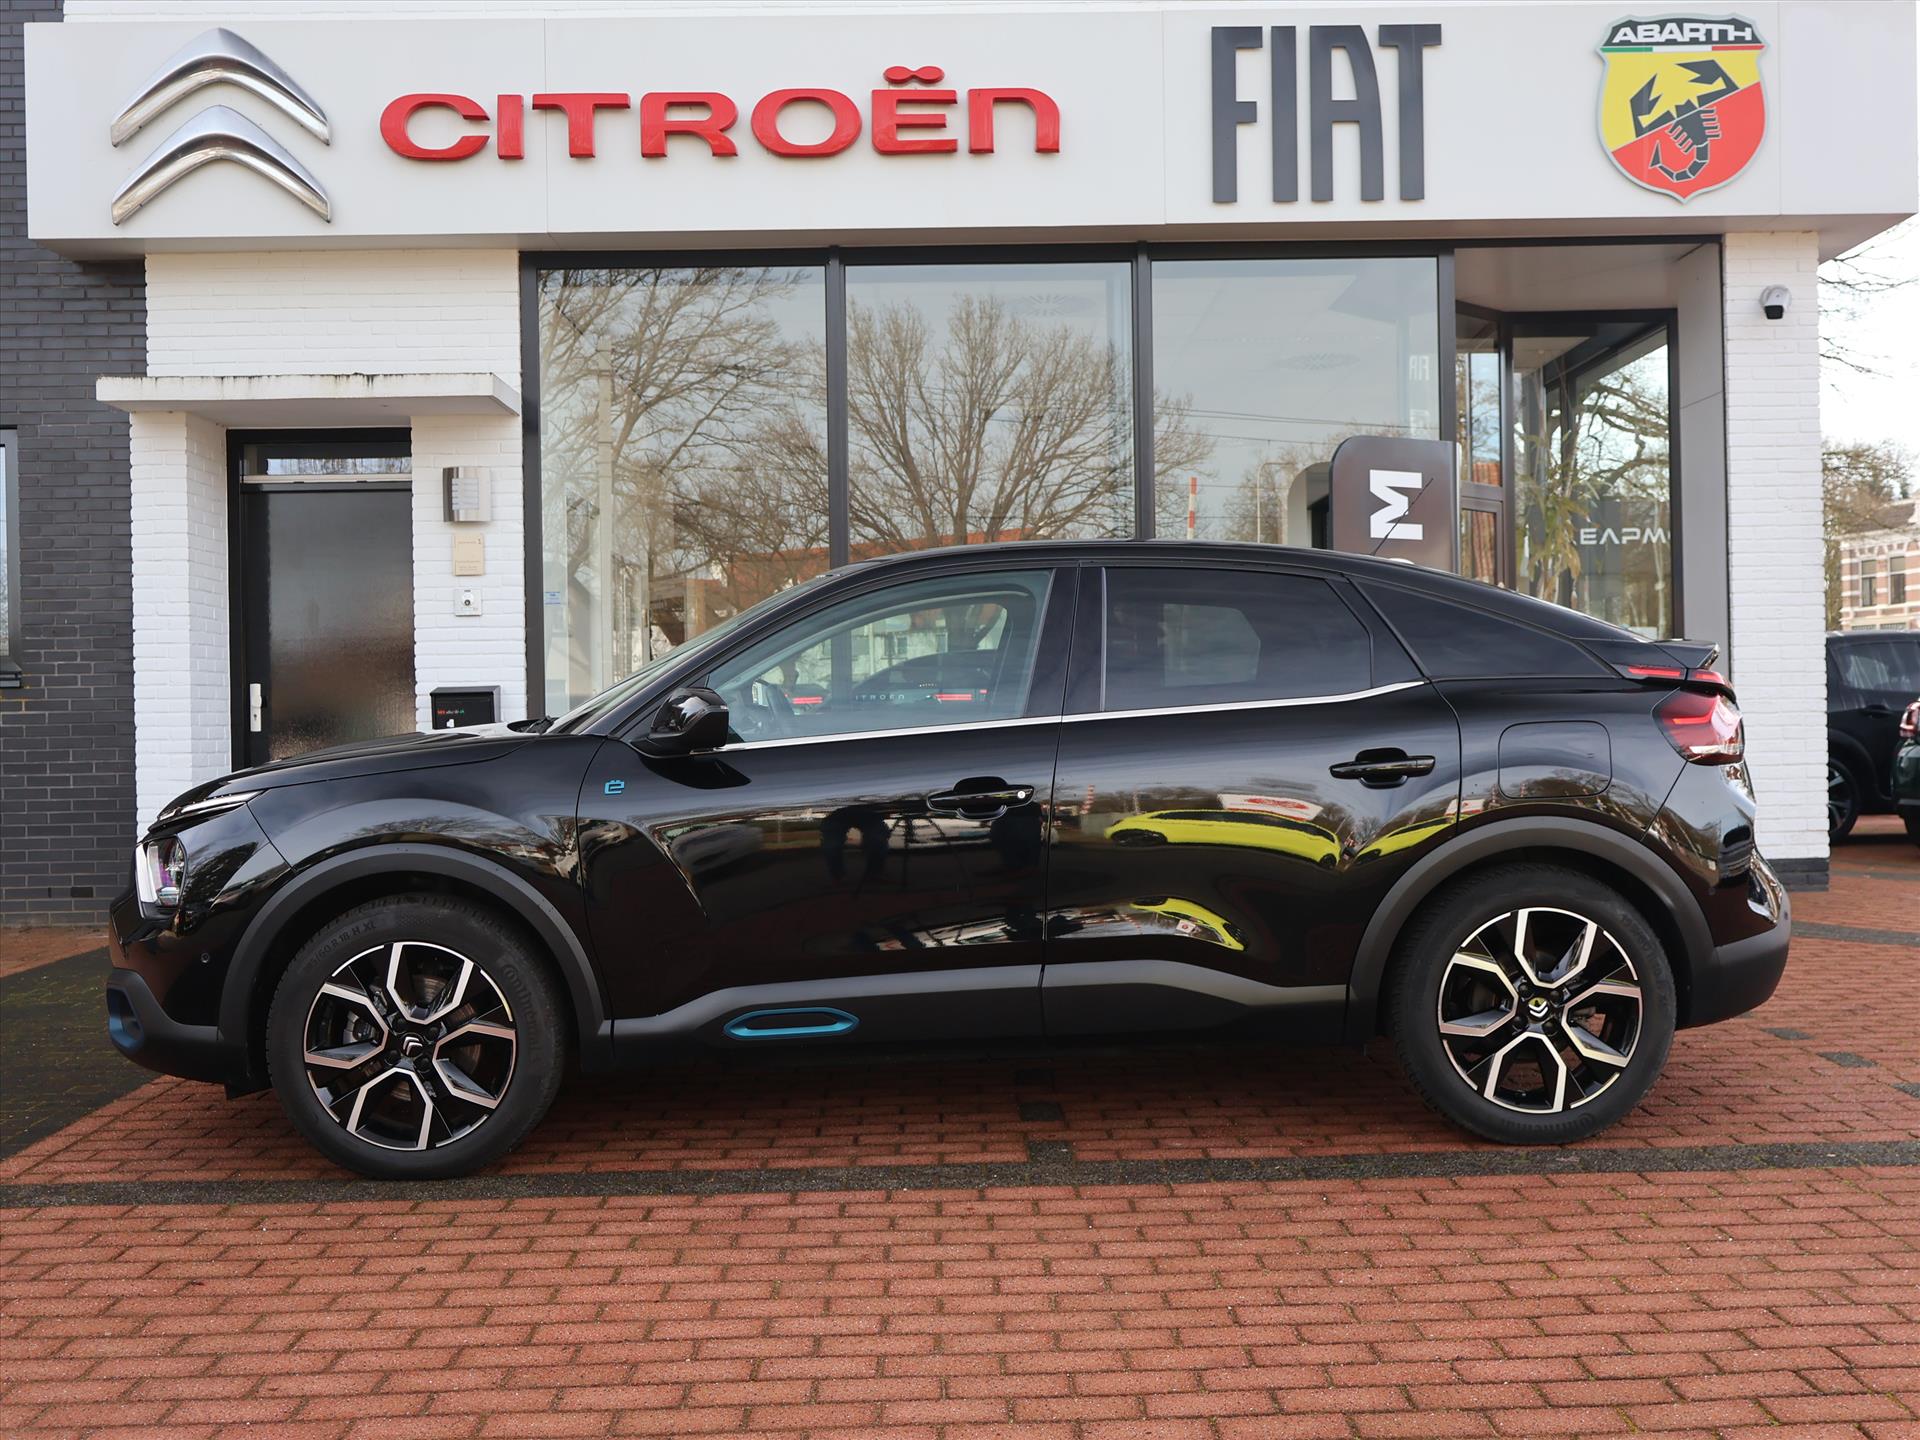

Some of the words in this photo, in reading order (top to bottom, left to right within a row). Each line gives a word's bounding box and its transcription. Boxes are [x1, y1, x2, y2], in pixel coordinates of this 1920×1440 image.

[1612, 22, 1752, 43] ABARTH
[1211, 24, 1440, 204] FIAT
[1579, 527, 1670, 545] EAPM
